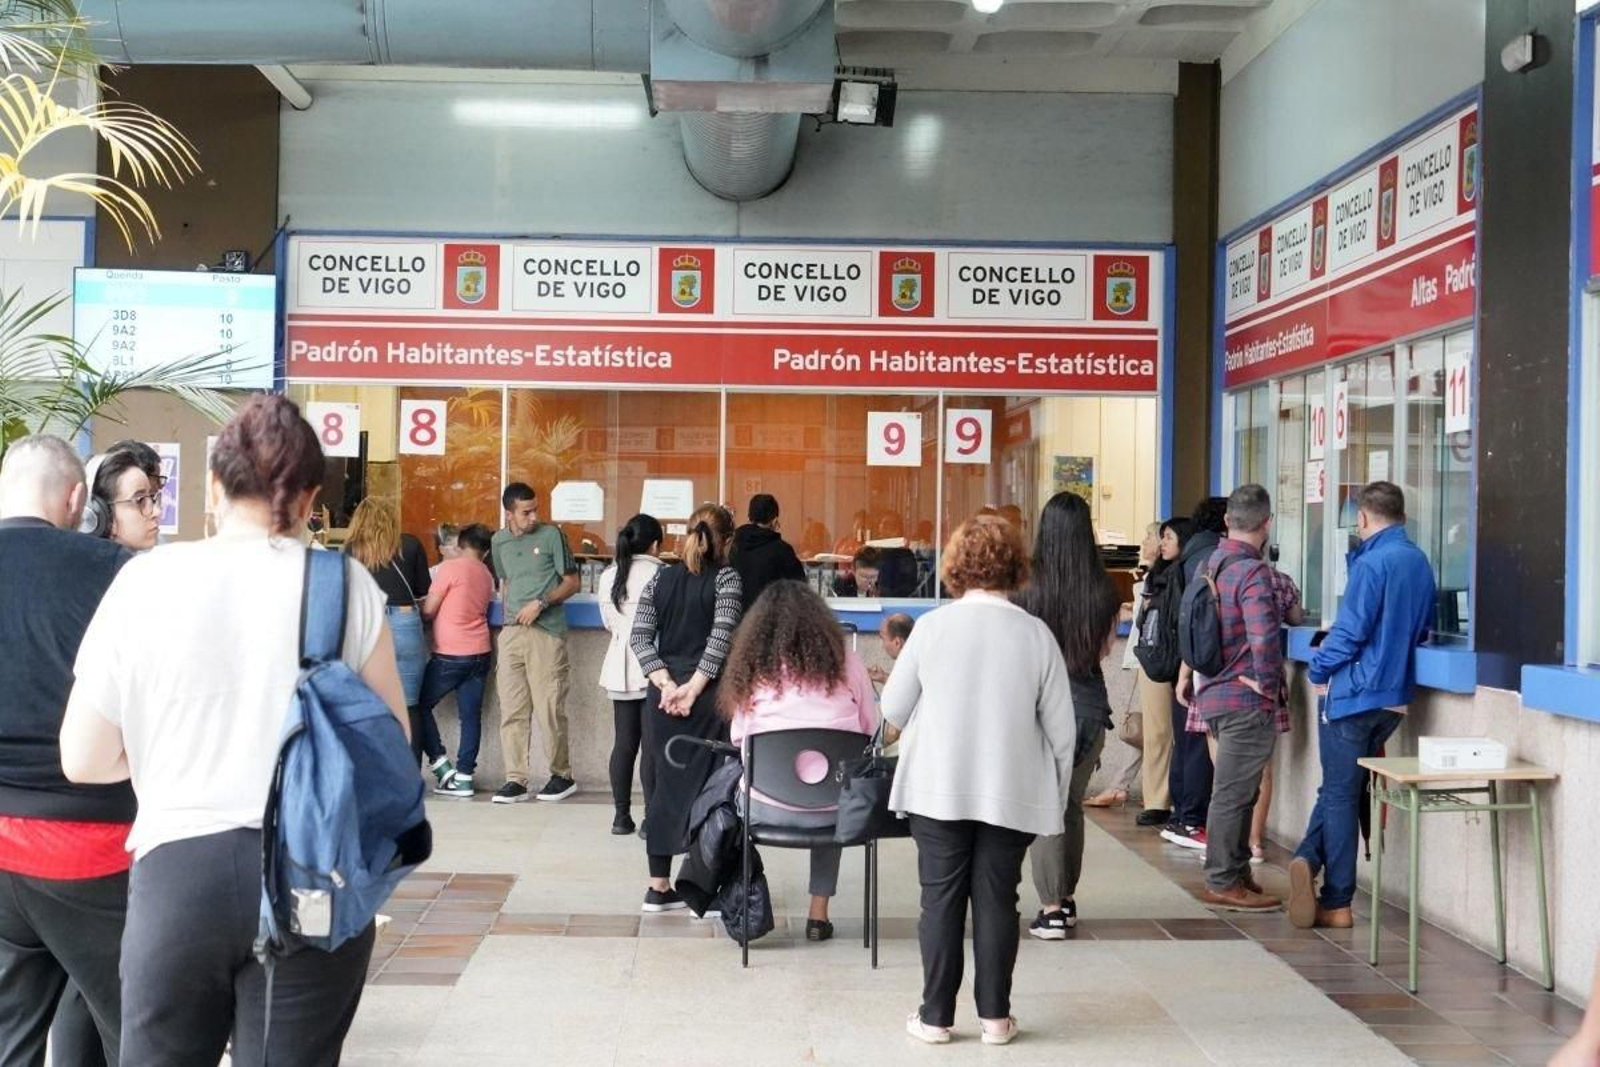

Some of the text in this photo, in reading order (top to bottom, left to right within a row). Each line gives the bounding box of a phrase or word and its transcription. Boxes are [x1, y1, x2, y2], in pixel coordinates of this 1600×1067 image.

[1405, 145, 1451, 189] CONCELLO
[1335, 188, 1373, 225] CONCELLO
[1409, 180, 1445, 217] DE VIGO
[1277, 223, 1308, 254] CONCELLO
[1338, 219, 1367, 251] DE VIGO
[308, 254, 426, 273] CONCELLO
[523, 258, 641, 277] CONCELLO
[743, 262, 861, 281] CONCELLO
[958, 266, 1076, 285] CONCELLO
[1279, 251, 1303, 278] DE VIGO
[322, 276, 411, 295] DE VIGO
[537, 280, 626, 299] DE VIGO
[757, 284, 847, 302] DE VIGO
[972, 287, 1062, 306] DE VIGO
[1410, 275, 1438, 308] Altas
[112, 310, 234, 324] 3D8 10
[112, 324, 233, 339] 9A2 10
[112, 340, 136, 351] 9A2
[291, 338, 673, 369] Padrón Habitantes-Estatística
[1224, 344, 1244, 372] Padrón
[773, 346, 1154, 377] Padrón Habitantes-Estatística
[1450, 365, 1466, 417] 11
[322, 412, 344, 446] 8
[409, 408, 437, 446] 8
[1312, 406, 1325, 446] 10
[1336, 392, 1345, 440] 6
[883, 422, 906, 455] 9
[955, 416, 982, 455] 9
